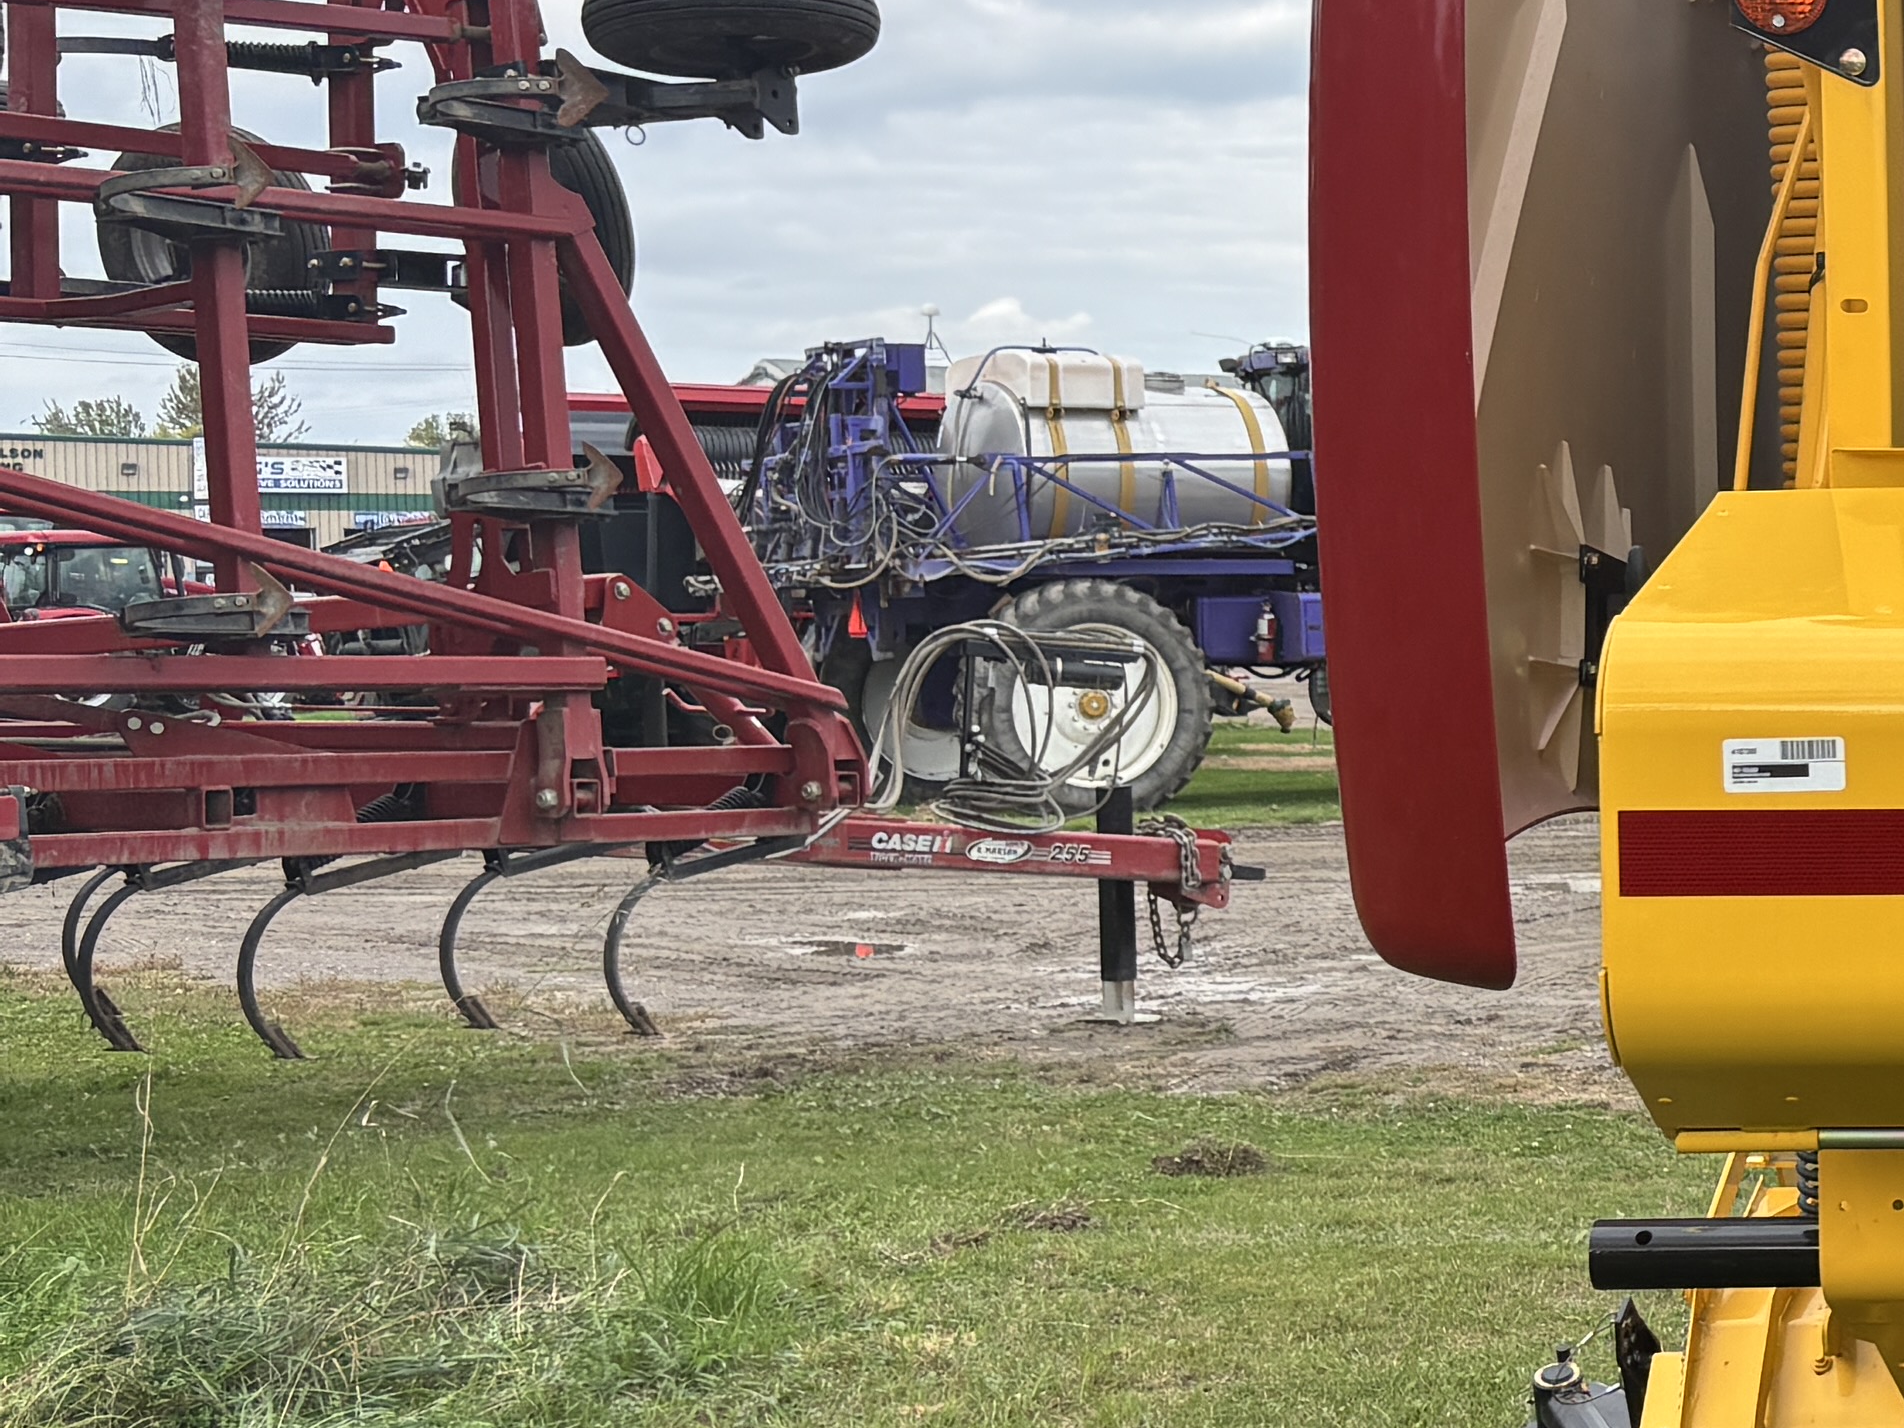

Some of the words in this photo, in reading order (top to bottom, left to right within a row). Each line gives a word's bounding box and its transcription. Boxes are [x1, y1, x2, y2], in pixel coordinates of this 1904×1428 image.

[280, 478, 342, 489] SOLUTIONS
[871, 831, 932, 852] CASE
[1049, 842, 1092, 864] 255
